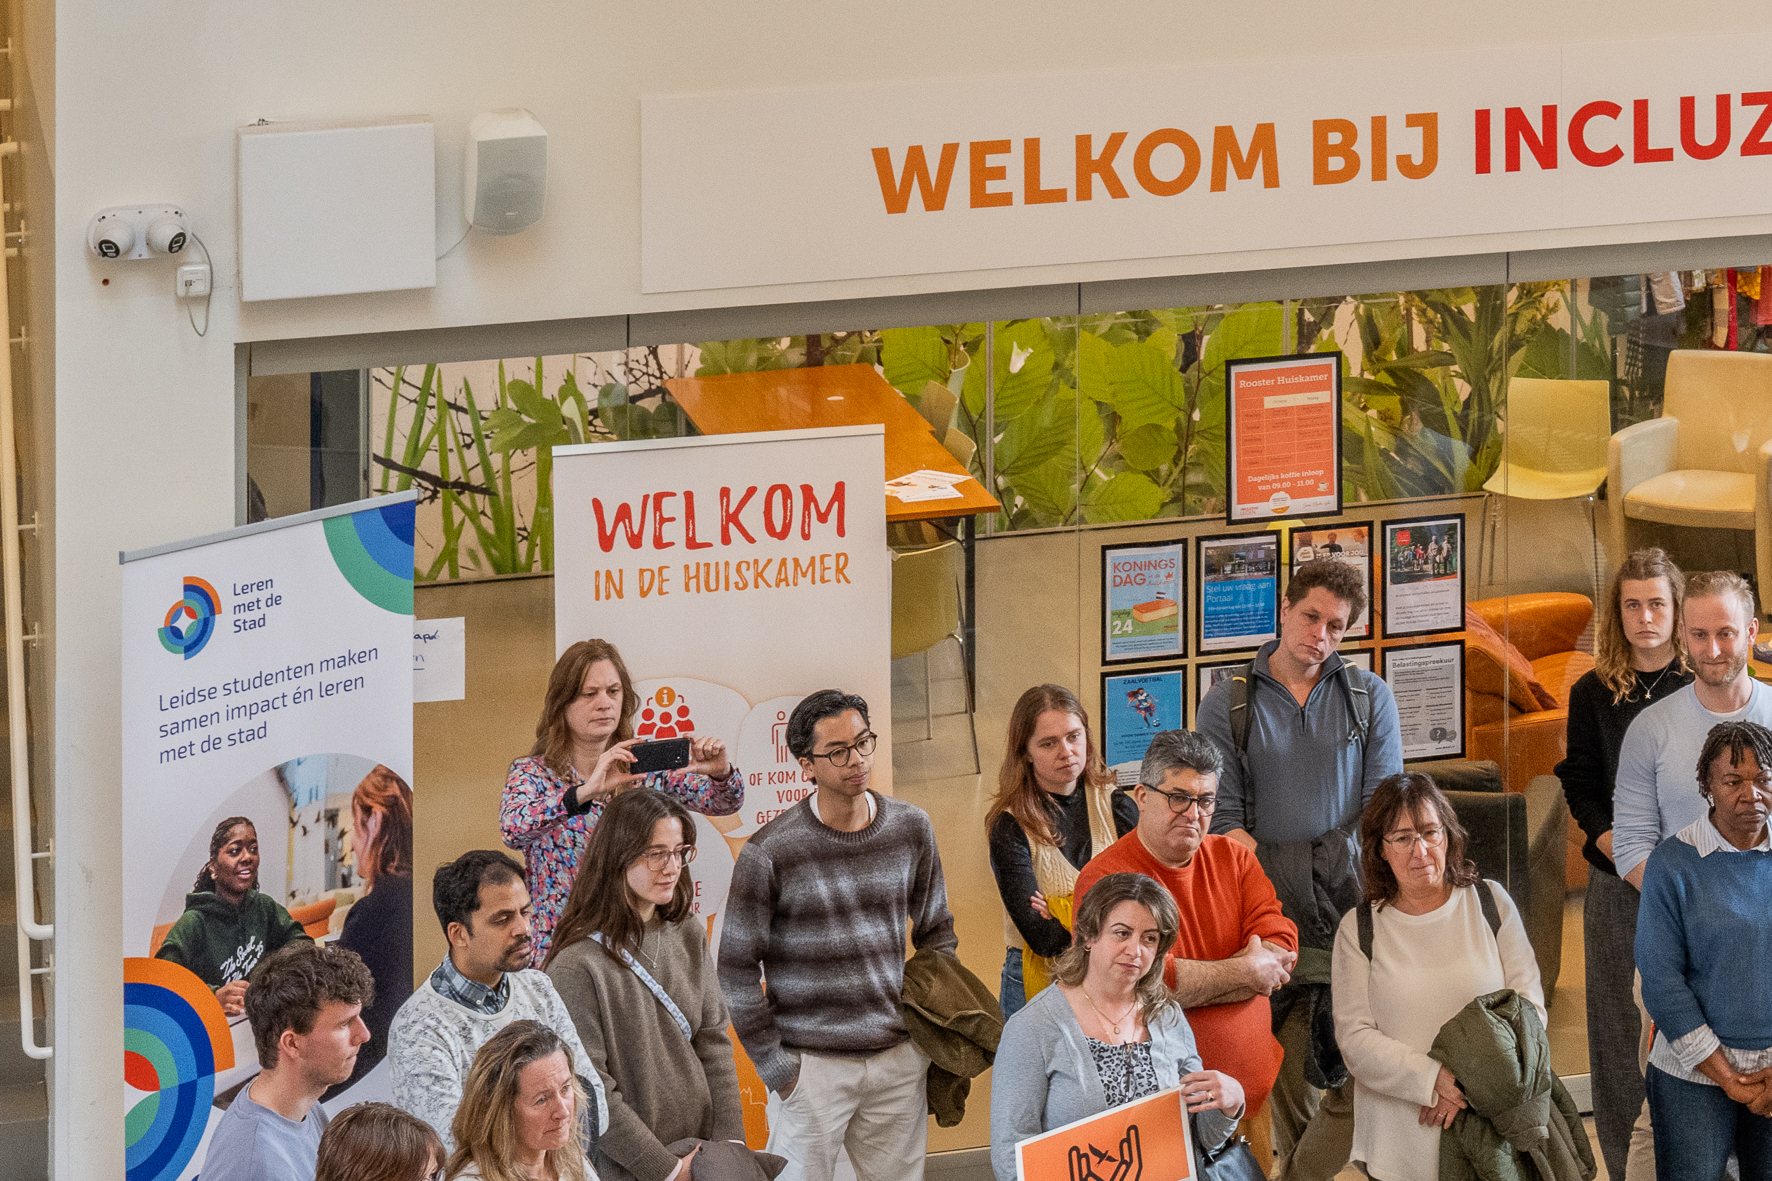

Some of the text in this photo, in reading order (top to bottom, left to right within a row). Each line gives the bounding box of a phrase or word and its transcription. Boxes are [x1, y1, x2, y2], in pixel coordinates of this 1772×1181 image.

[871, 123, 1281, 216] WELKOM
[1311, 112, 1441, 188] BIJ
[1239, 373, 1328, 388] Rooster Huiskamer
[592, 481, 846, 552] WELKOM
[1113, 558, 1175, 573] KONINGS
[594, 552, 851, 601] IN DE HUISKAMER
[1113, 573, 1146, 588] DAG
[233, 578, 274, 596] Leren
[233, 593, 282, 615] met de
[233, 614, 266, 633] Stad
[1112, 619, 1133, 635] 24
[1392, 657, 1454, 669] Belastingspreekuur
[159, 682, 218, 712] Leidse
[223, 661, 314, 697] studenten
[320, 647, 378, 673] maken
[1123, 677, 1163, 685] ZAALVOETBAL
[159, 675, 365, 738] samen impact én leren
[159, 722, 267, 764] met de stad
[750, 773, 763, 786] OF
[768, 770, 796, 785] KOM
